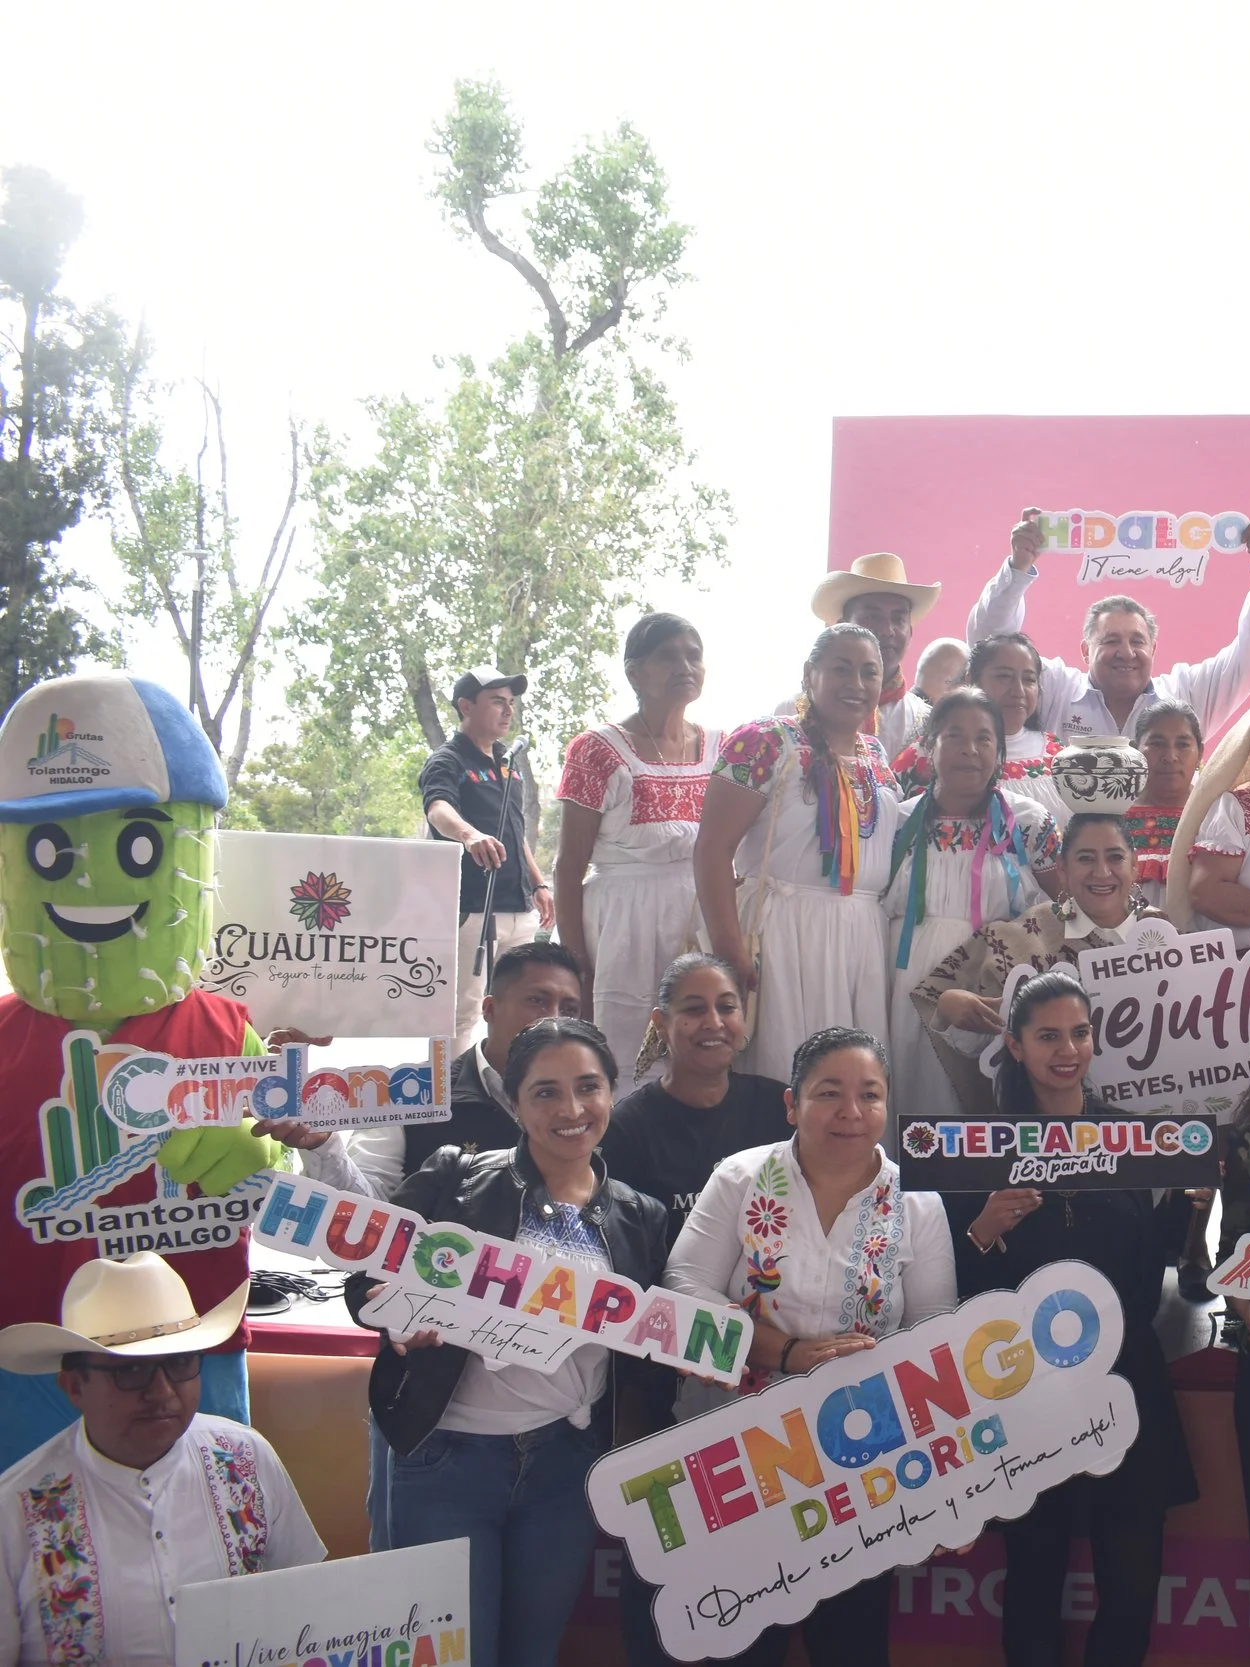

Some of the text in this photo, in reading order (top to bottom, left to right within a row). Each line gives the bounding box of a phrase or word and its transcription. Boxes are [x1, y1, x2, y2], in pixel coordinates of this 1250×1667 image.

[1156, 555, 1204, 584] algo!
[65, 731, 104, 742] Grutas
[27, 766, 111, 777] Tolantongo
[49, 776, 93, 784] HIDALGO
[213, 923, 418, 968] CUAUTEPEC
[1091, 941, 1225, 980] HECHO EN
[268, 965, 310, 988] Seguro
[327, 967, 367, 990] quedas
[176, 1060, 277, 1077] #VEN Y VIVE
[107, 1040, 447, 1130] Cardonal
[1101, 1073, 1183, 1103] REYES,
[339, 1118, 349, 1126] EN
[363, 1115, 387, 1123] VALLE
[390, 1113, 402, 1121] DEL
[405, 1110, 448, 1120] MEZQUITAL
[938, 1123, 1210, 1154] TEPEAPULCO
[1013, 1160, 1044, 1180] ¡Es
[1050, 1160, 1089, 1179] para
[104, 1225, 231, 1256] HIDALGO
[259, 1181, 743, 1373] HUICHAPAN
[456, 1313, 570, 1365] Historia!
[790, 1482, 858, 1542] DE
[685, 1558, 812, 1631] ¡Donde
[820, 1545, 855, 1568] se
[859, 1504, 937, 1550] borda
[946, 1496, 959, 1520] y
[965, 1477, 999, 1500] se
[994, 1445, 1063, 1490] toma
[295, 1623, 322, 1658] la
[325, 1624, 394, 1658] magia
